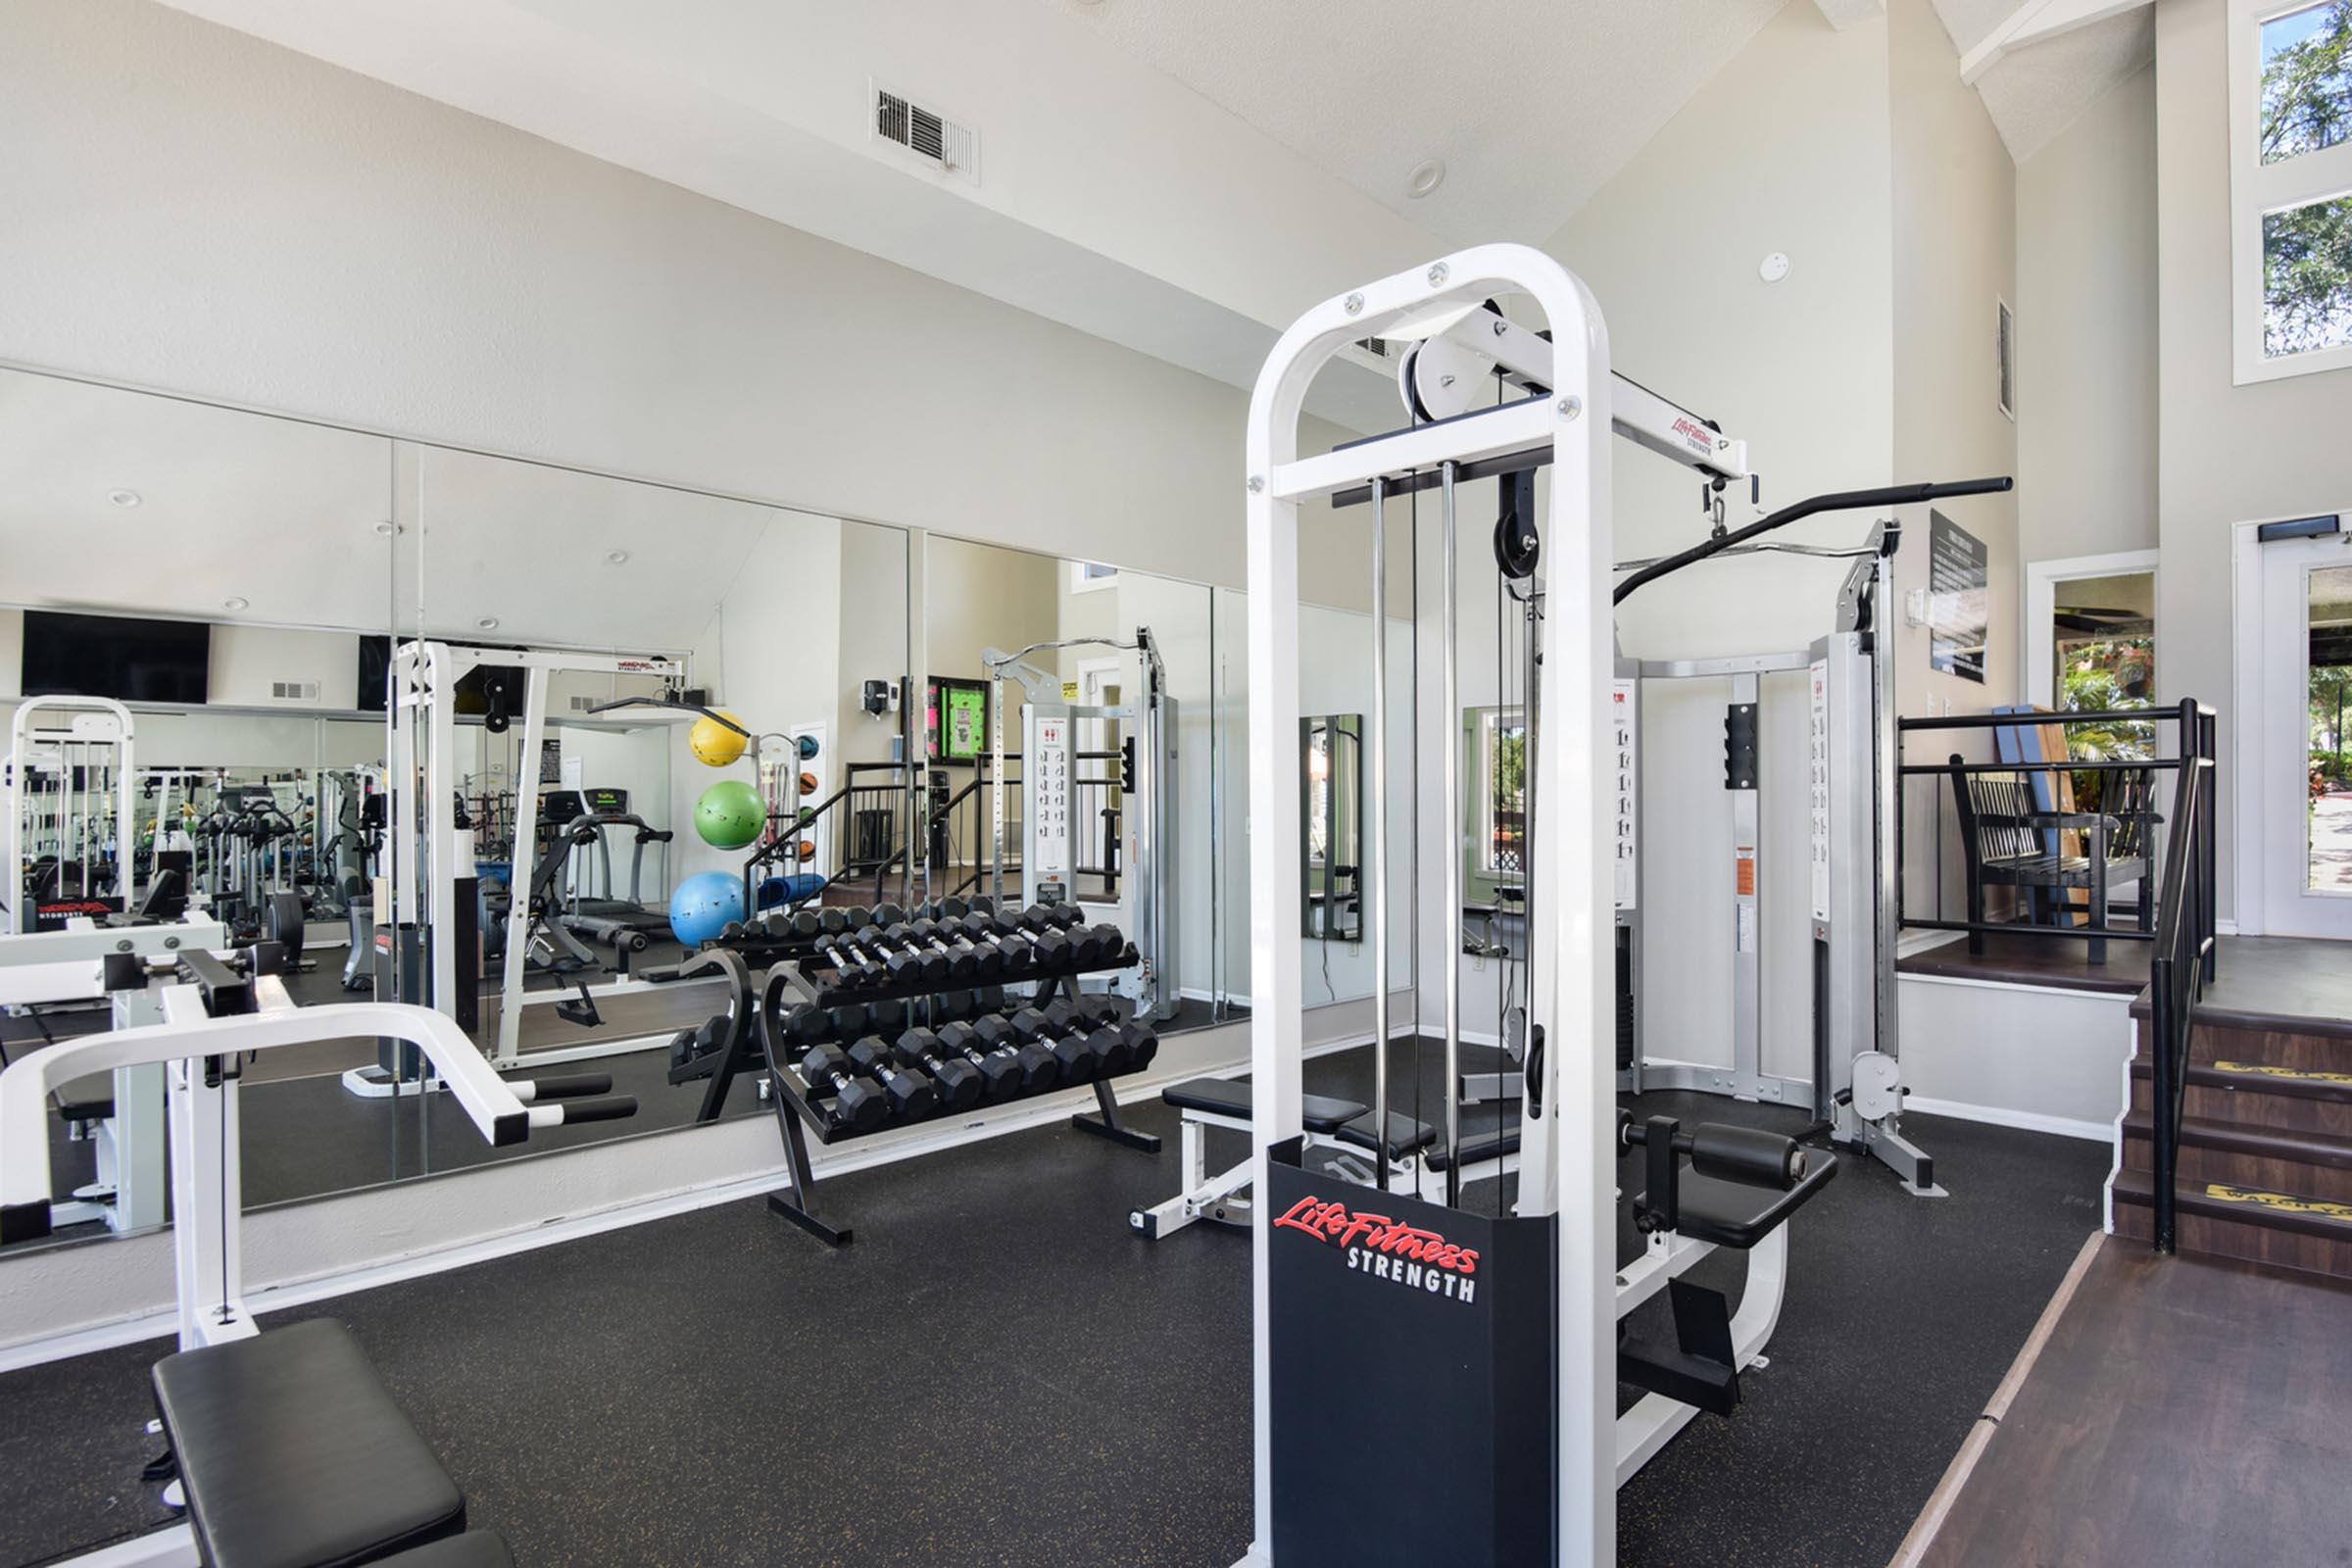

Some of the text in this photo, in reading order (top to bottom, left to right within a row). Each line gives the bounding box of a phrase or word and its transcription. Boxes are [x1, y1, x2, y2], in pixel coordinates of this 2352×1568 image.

[1274, 1196, 1480, 1274] Life Fitness
[1348, 1247, 1475, 1303] STRENGTH
